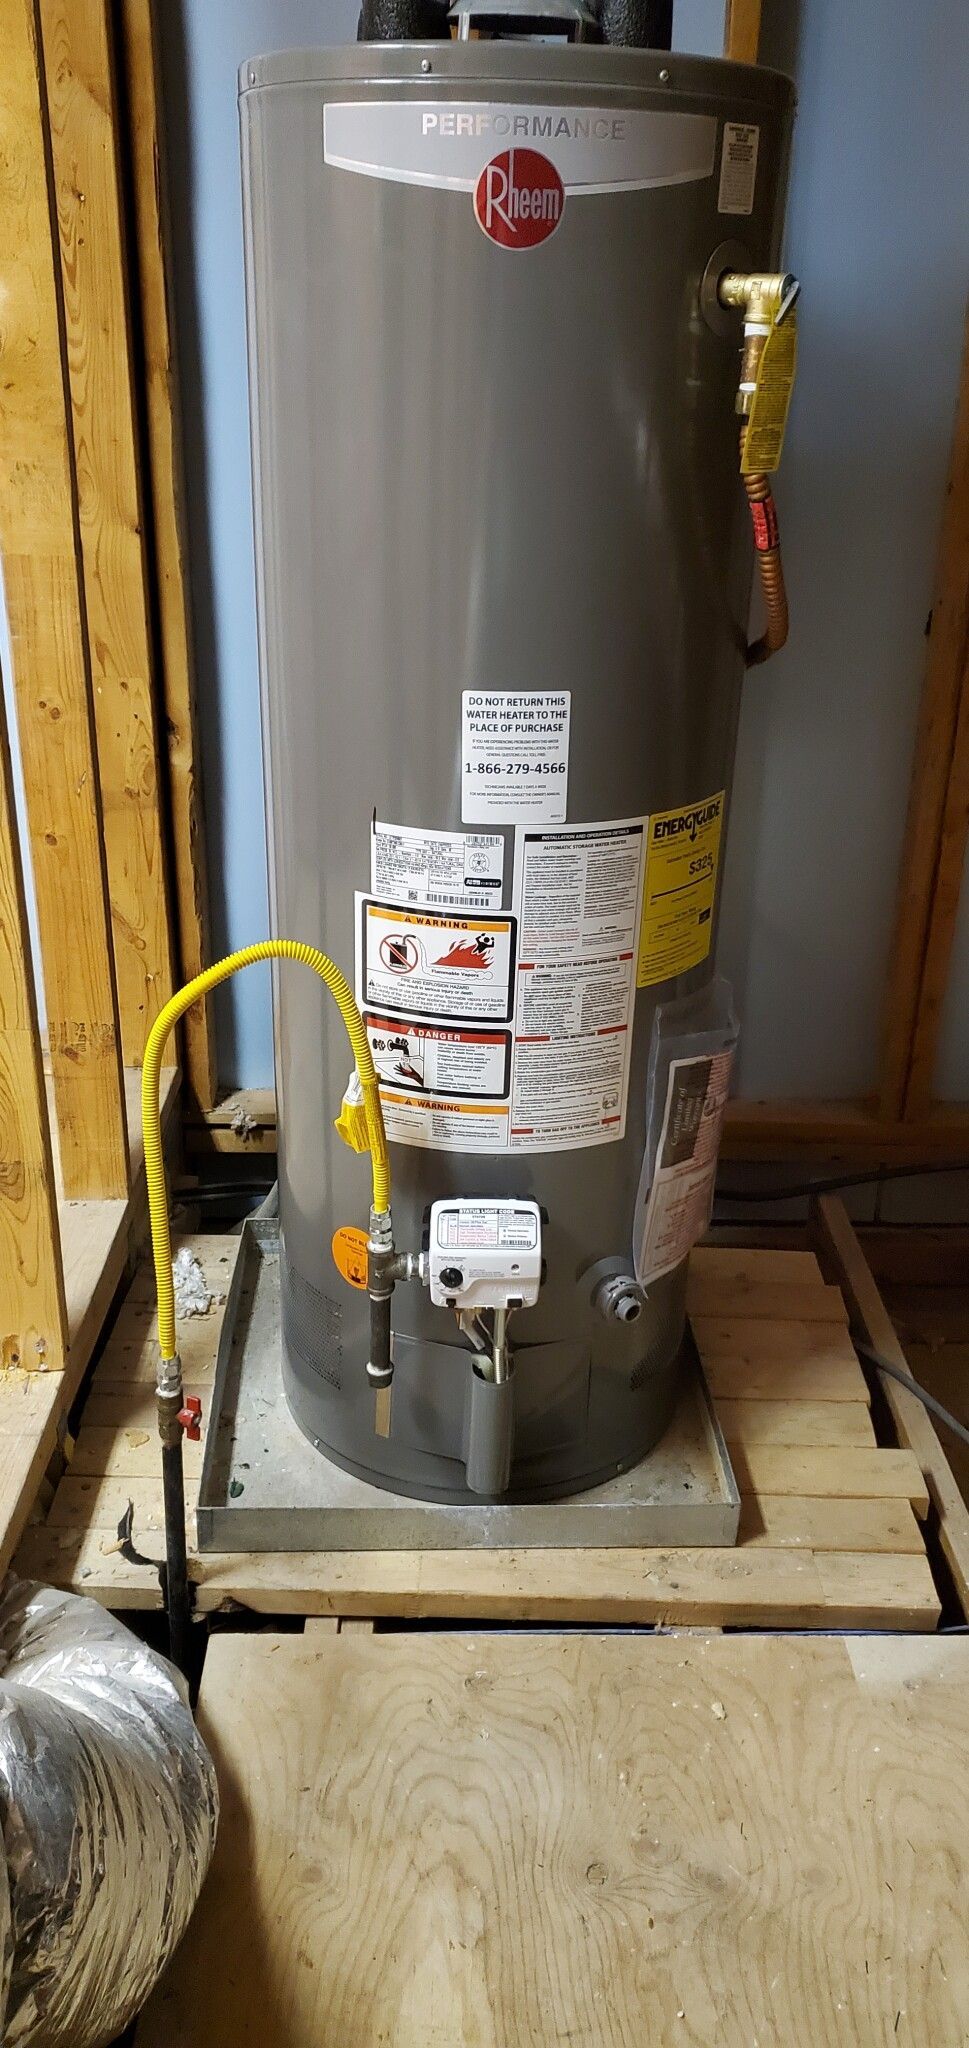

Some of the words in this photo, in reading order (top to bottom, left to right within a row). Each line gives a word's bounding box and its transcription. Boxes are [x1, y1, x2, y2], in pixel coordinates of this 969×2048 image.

[422, 112, 626, 141] PERFORMANCE
[486, 147, 559, 232] Rheem
[469, 697, 483, 706] DO
[485, 697, 505, 706] NOT
[507, 698, 543, 706] RETURN
[546, 697, 565, 706] THIS
[467, 711, 497, 719] WATER
[500, 711, 534, 719] HEATER
[536, 711, 548, 719] TO
[550, 711, 567, 719] THE
[470, 723, 498, 732] PLACE
[501, 724, 513, 732] OF
[515, 723, 563, 732] PURCHASE
[465, 762, 566, 774] 1-866-279-4566
[417, 918, 469, 930] WARNING
[419, 1029, 461, 1041] DANGER
[418, 1101, 461, 1112] WARNING
